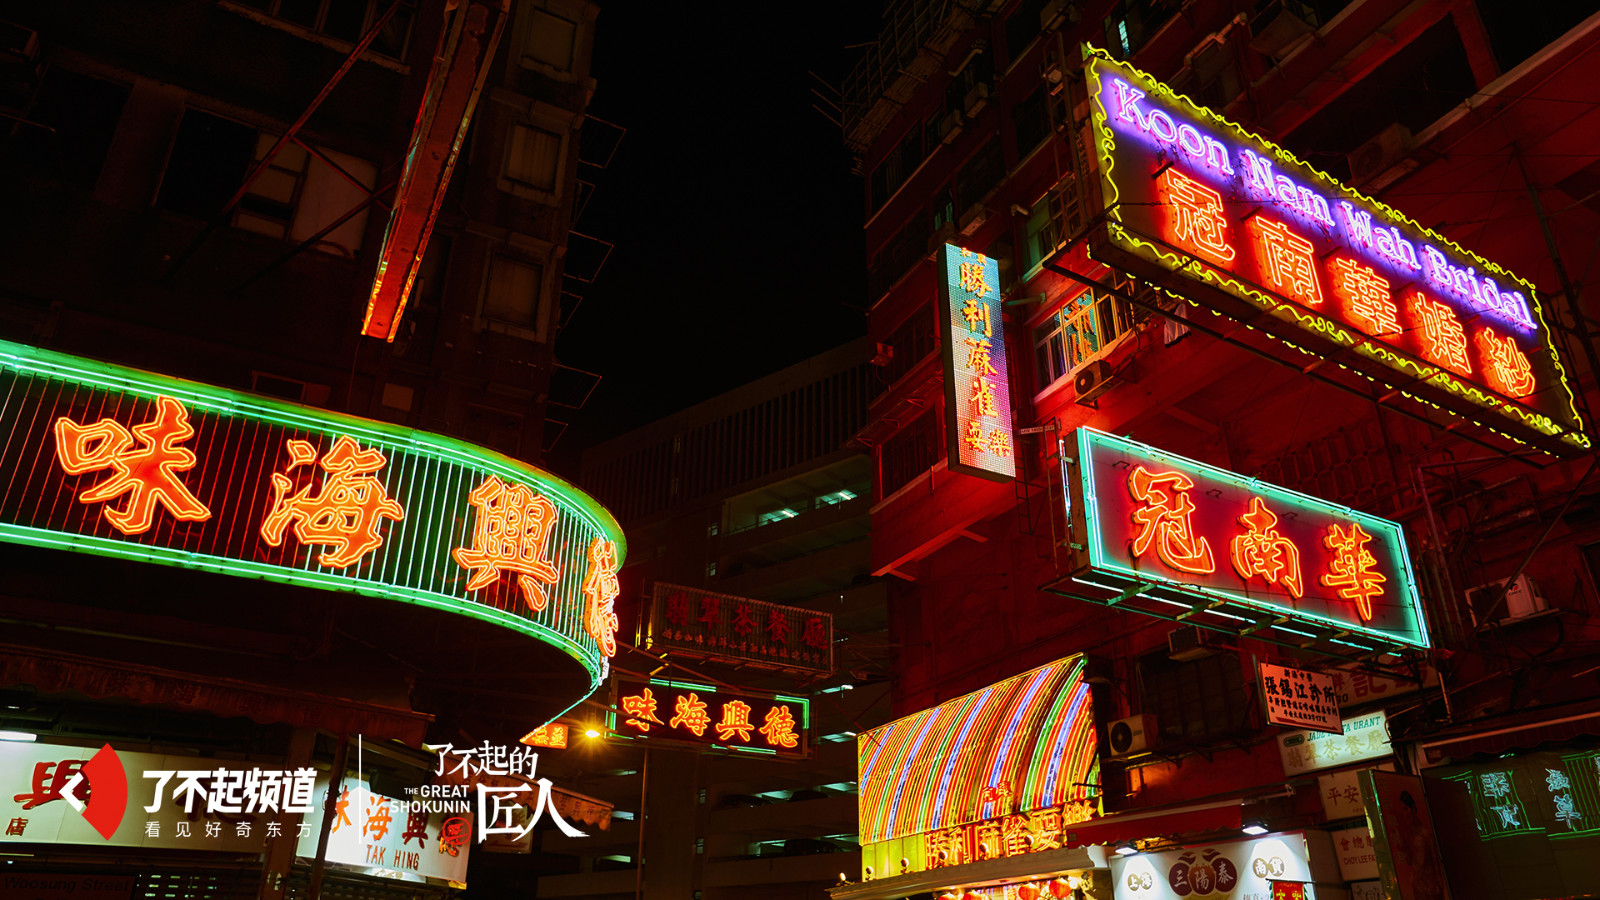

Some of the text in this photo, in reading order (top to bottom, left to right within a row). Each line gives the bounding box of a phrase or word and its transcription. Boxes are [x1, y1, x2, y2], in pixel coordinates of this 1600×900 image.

[1112, 77, 1539, 331] Koon Nam Wah Bridal
[1157, 167, 1537, 398] 冠南華婚紗
[1127, 464, 1387, 622] 冠南華
[5, 817, 29, 837] 店
[366, 844, 420, 871] TAK HING
[4, 876, 131, 892] Woosung Street
[1176, 861, 1234, 891] 三陽泰
